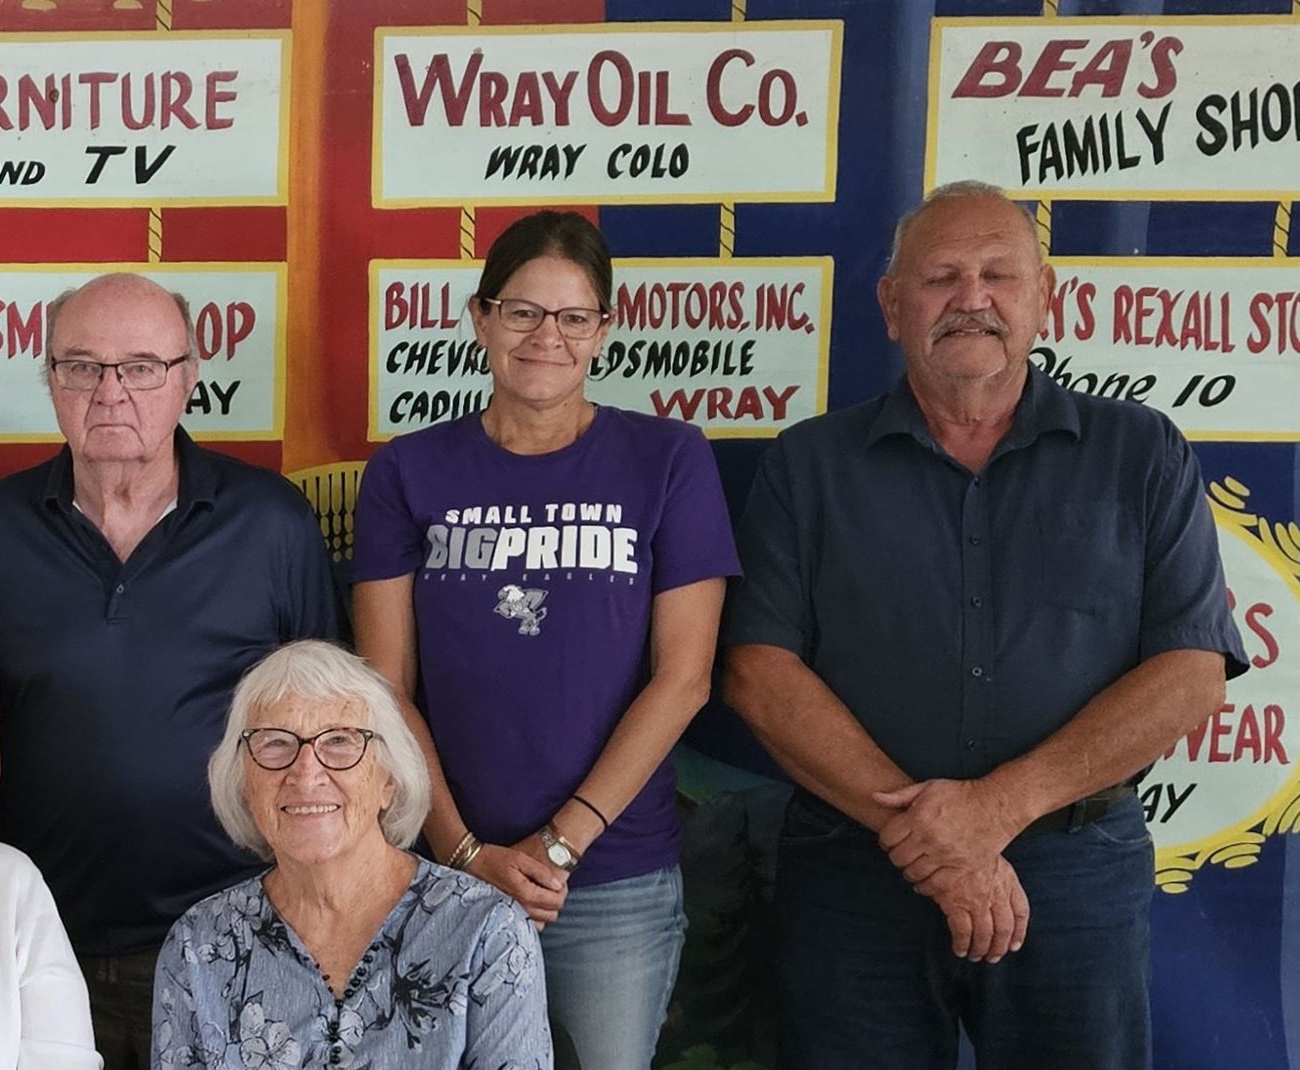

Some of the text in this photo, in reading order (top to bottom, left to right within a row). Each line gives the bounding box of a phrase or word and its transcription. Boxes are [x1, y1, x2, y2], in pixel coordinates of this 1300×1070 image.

[951, 31, 1184, 98] BEA'S
[484, 142, 689, 181] WRAY COLO
[1016, 101, 1172, 186] FAMILY
[84, 145, 176, 184] TV
[385, 281, 460, 330] BILL
[755, 282, 815, 334] INC.
[1113, 284, 1235, 353] REXALL
[196, 302, 256, 361] OP
[590, 339, 756, 378] LDSMOBILE
[650, 385, 800, 421] WRAY
[1172, 374, 1236, 407] 10
[445, 503, 622, 525] SMALL TOWN
